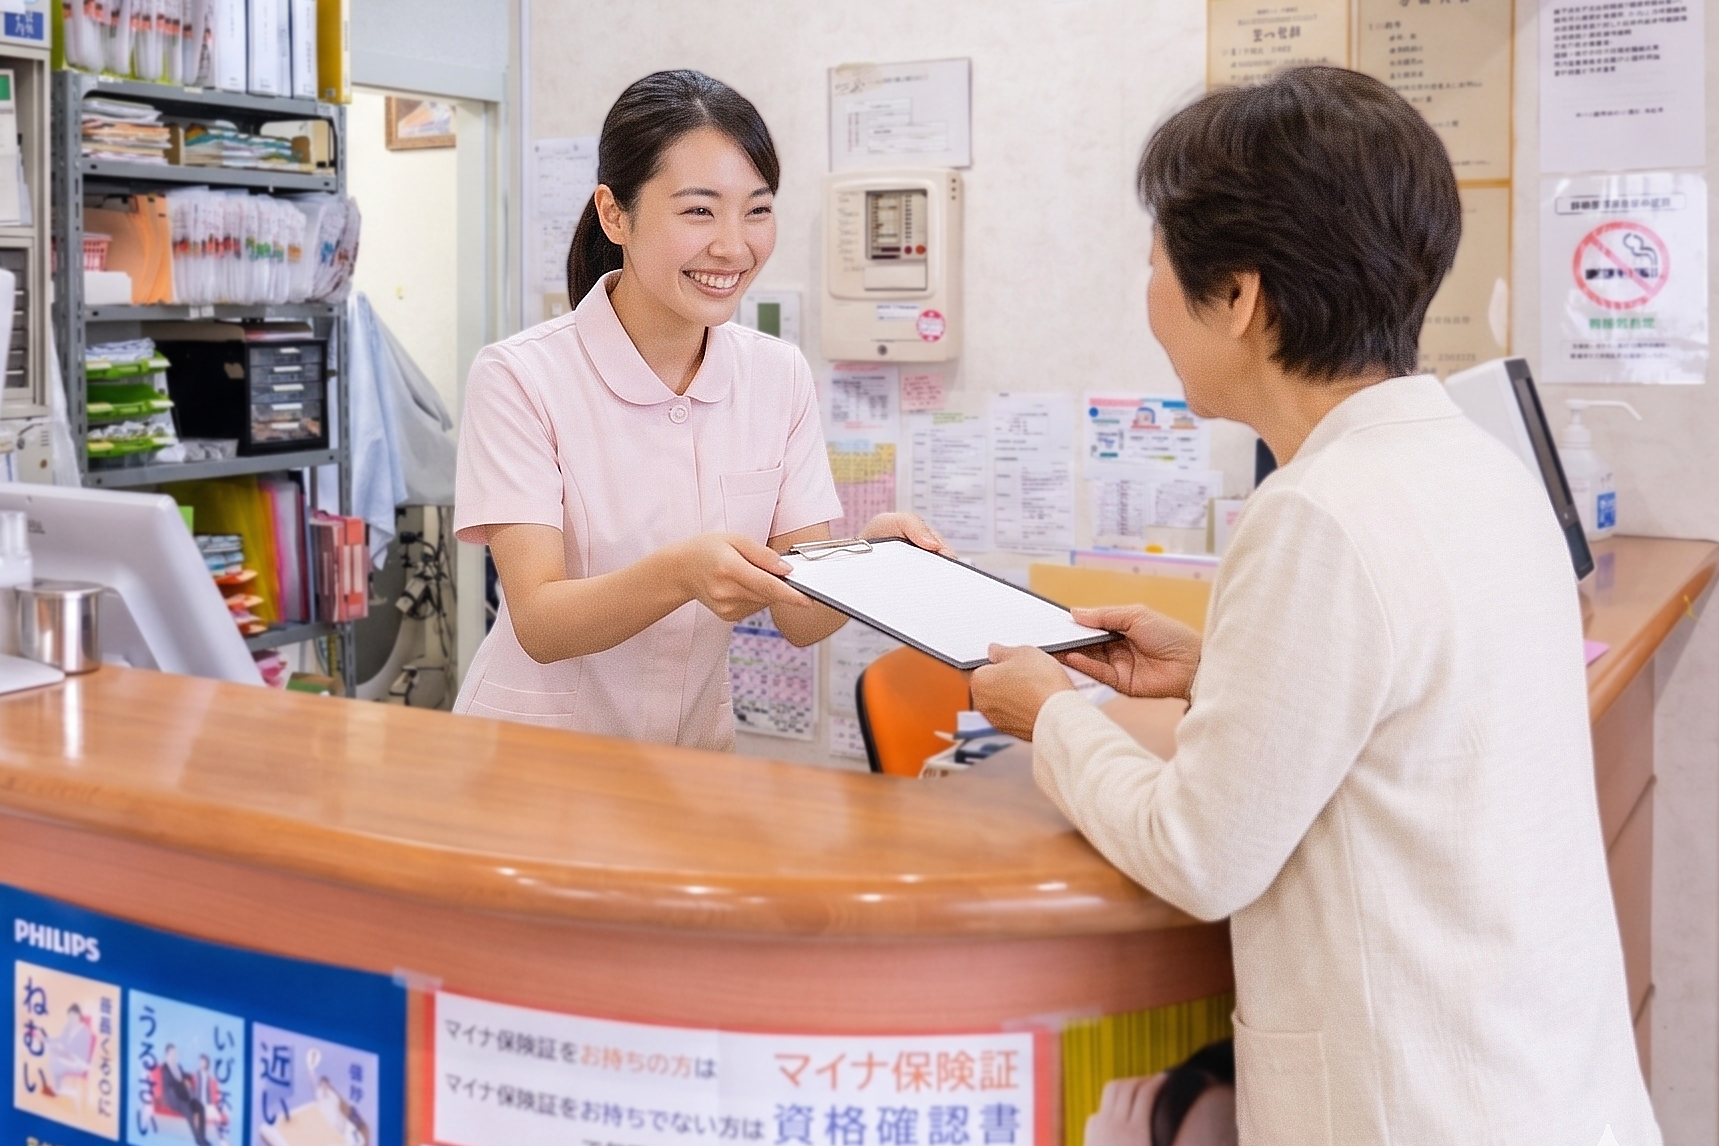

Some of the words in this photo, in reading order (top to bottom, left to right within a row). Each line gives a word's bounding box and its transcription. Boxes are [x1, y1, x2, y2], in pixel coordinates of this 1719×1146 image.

[14, 918, 101, 962] PHILIPS
[23, 976, 48, 1093] ねむい
[445, 1018, 718, 1079] マイナ保険証をお持ちの方は
[136, 1005, 158, 1137] うるさい
[260, 1042, 291, 1125] 近い
[774, 1050, 1020, 1093] マイナ保険証
[445, 1073, 765, 1140] マイナ保険証をお持ちでない方は
[774, 1103, 1021, 1146] 資格確認書
